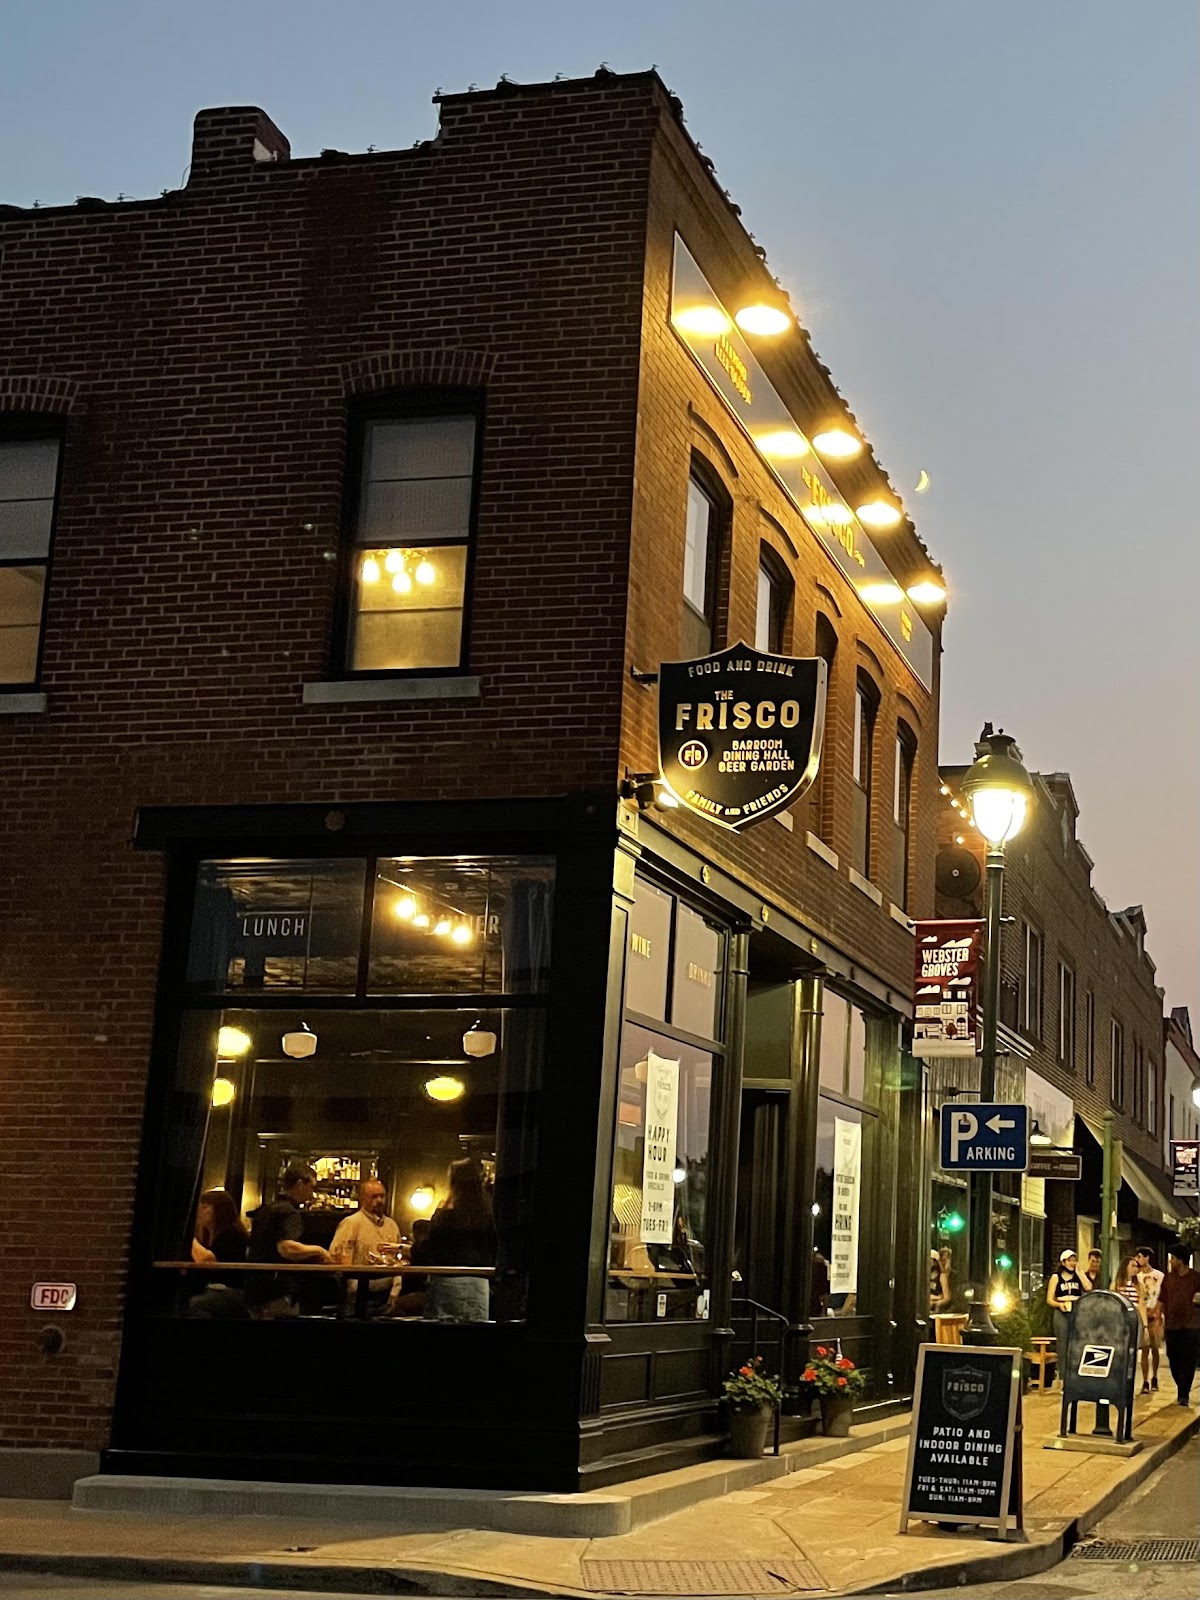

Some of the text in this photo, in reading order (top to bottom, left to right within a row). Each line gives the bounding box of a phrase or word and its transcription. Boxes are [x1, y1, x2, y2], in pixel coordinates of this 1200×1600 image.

[688, 660, 796, 678] FOOD AND DRINK
[714, 690, 734, 701] THE
[675, 700, 800, 731] FRISCO
[732, 739, 783, 750] BARROOM
[722, 749, 791, 762] DINING HALL
[718, 760, 795, 773] BEER GARDEN
[684, 789, 724, 816] FAMILY
[742, 783, 789, 815] FRIENDS
[242, 917, 306, 938] LUNCH
[631, 932, 652, 959] WINE
[922, 947, 970, 964] WEBSTER
[921, 962, 959, 977] GROVES
[647, 1124, 670, 1144] HAPPY
[647, 1144, 667, 1163] HOUR
[40, 1288, 69, 1304] FDC
[946, 1381, 984, 1393] FRISCO
[933, 1426, 991, 1439] PATIO AND
[919, 1438, 1002, 1454] INDOOR DINING
[930, 1453, 989, 1466] AVAILABLE
[917, 1484, 929, 1492] FRI
